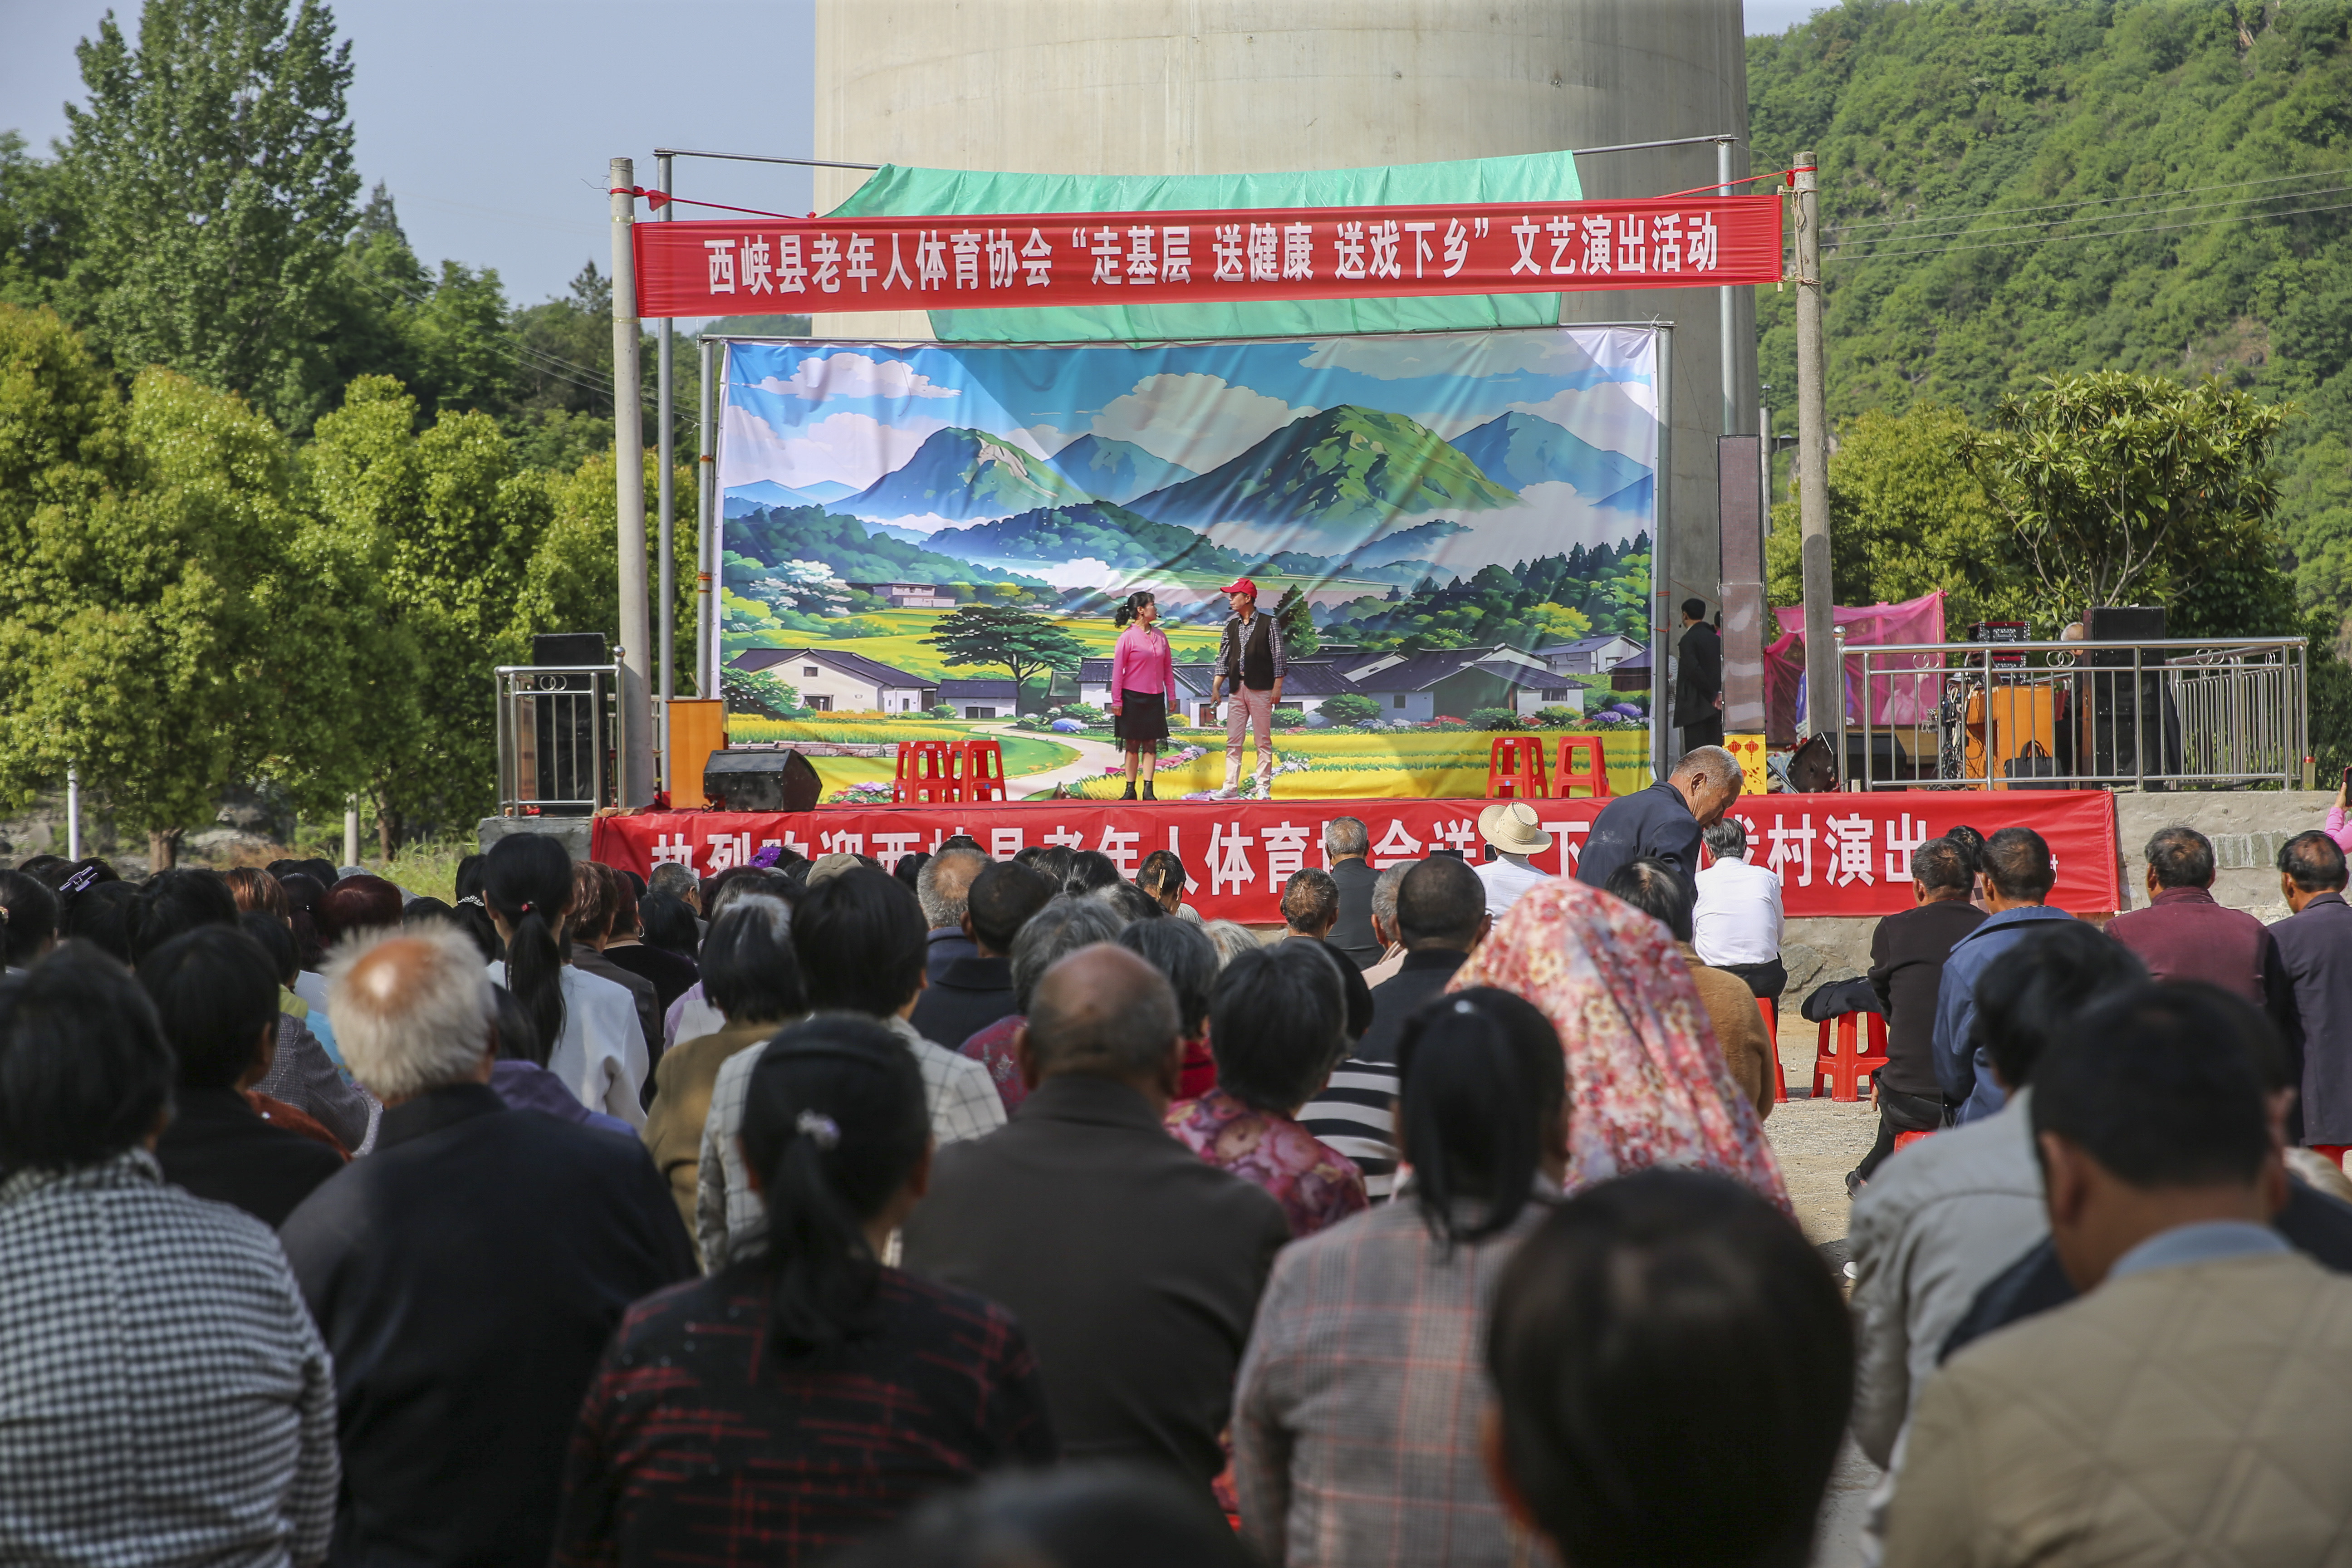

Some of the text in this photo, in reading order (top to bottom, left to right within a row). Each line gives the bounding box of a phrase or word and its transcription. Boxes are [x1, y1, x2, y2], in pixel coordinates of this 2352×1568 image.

[703, 227, 1052, 296] 西峡县老年人体育协会
[1212, 221, 1314, 282] 送健康
[1509, 211, 1718, 276] 文艺演出活动
